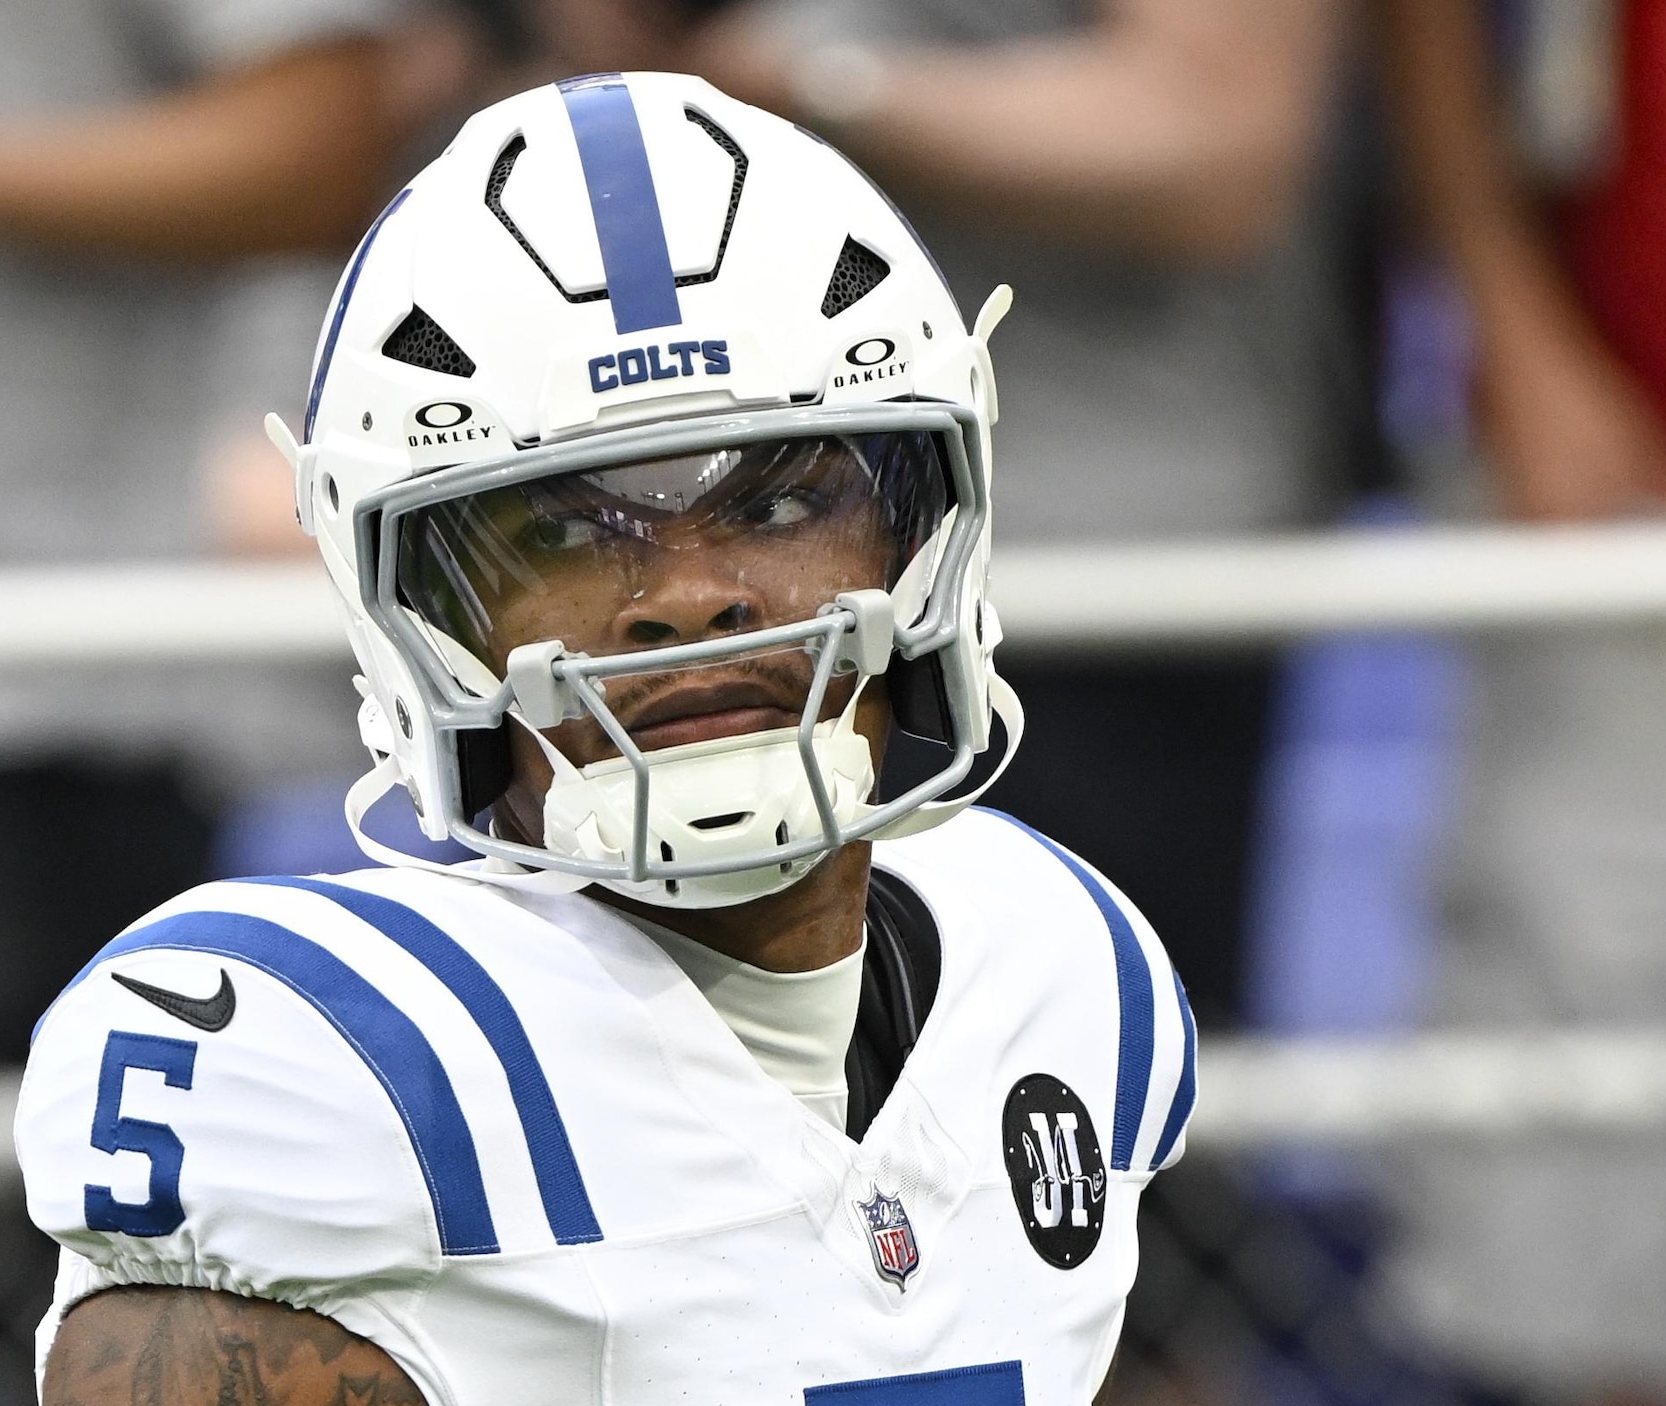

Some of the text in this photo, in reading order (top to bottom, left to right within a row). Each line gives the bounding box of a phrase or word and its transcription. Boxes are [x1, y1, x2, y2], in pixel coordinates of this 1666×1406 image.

[587, 340, 731, 393] COLTS
[834, 362, 907, 387] OAKLEY
[408, 427, 491, 447] OAKLEY
[84, 1029, 198, 1237] 5
[876, 1228, 916, 1270] NFL
